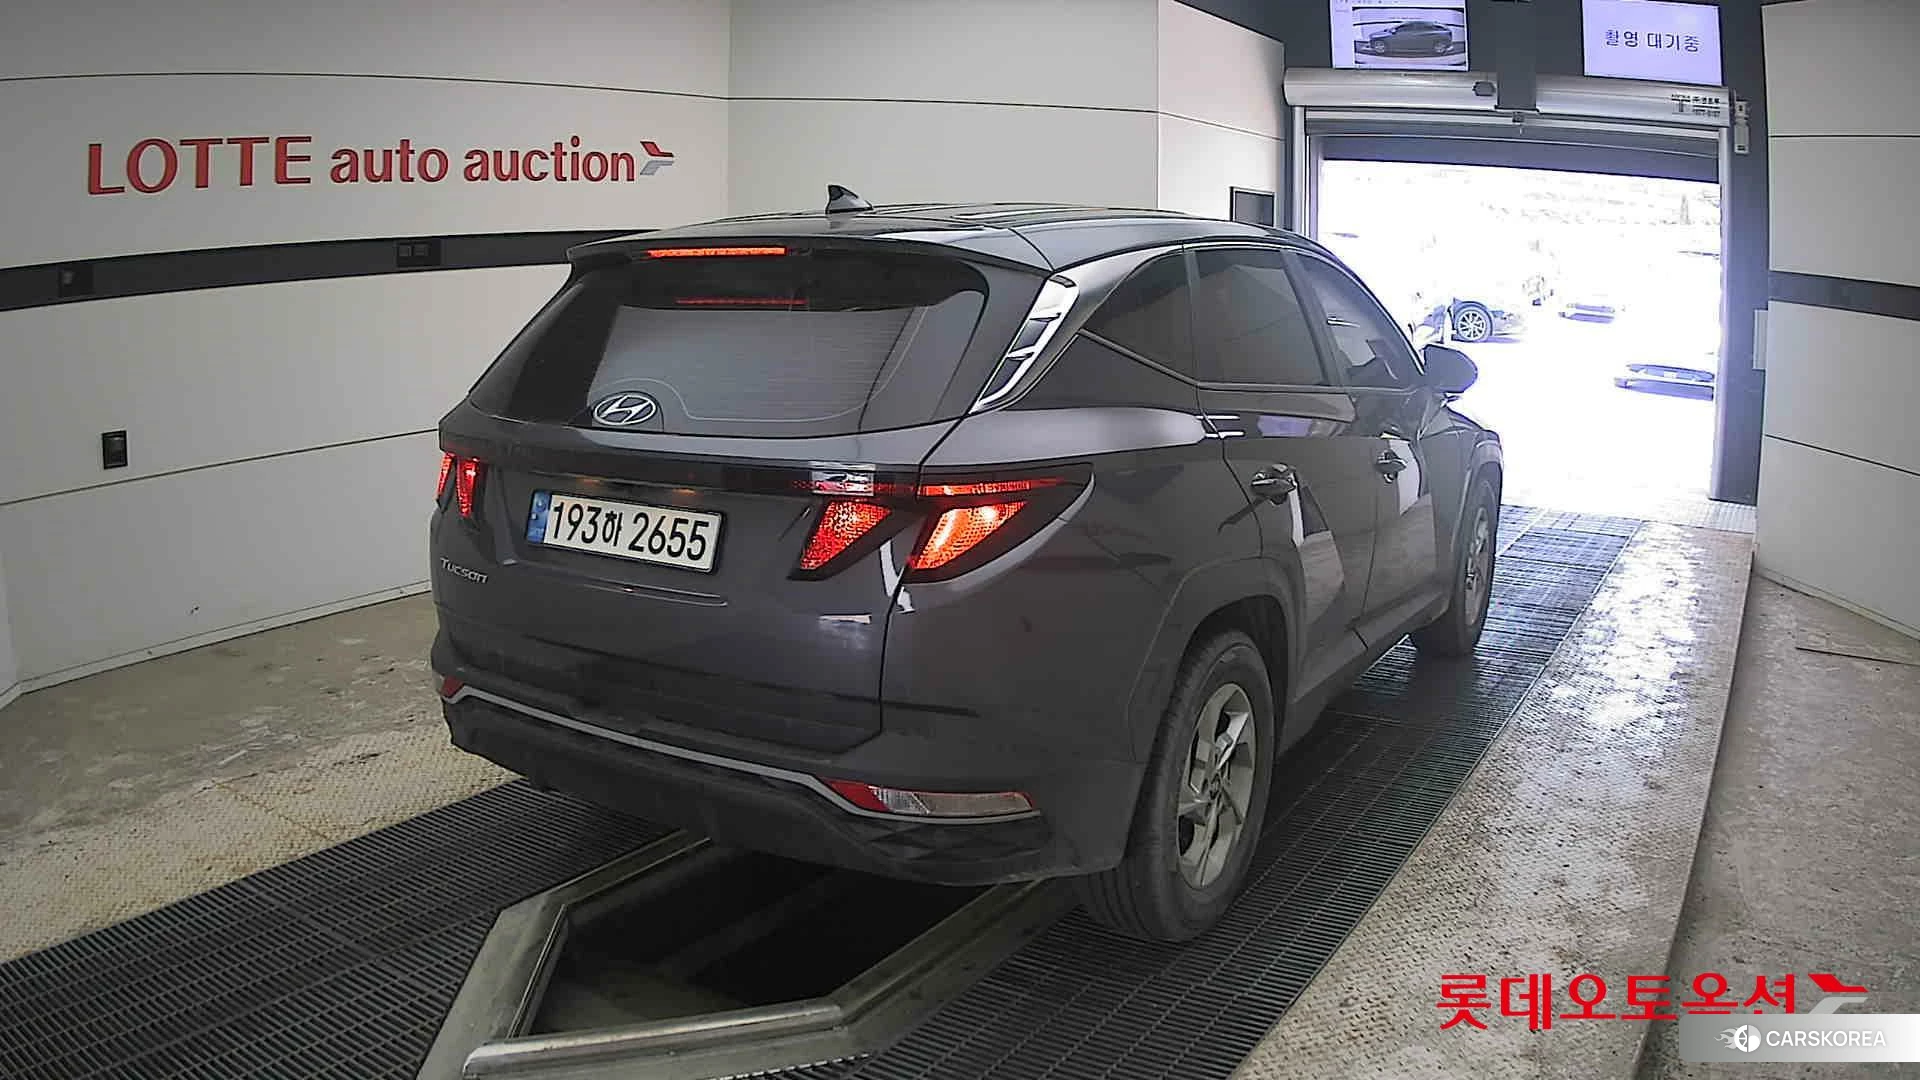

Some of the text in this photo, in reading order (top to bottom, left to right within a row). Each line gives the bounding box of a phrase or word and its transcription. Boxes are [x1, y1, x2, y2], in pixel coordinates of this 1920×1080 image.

[1647, 32, 1699, 53] 대기중
[87, 134, 635, 195] LOTTE auto auction
[552, 501, 710, 561] 193하 2655
